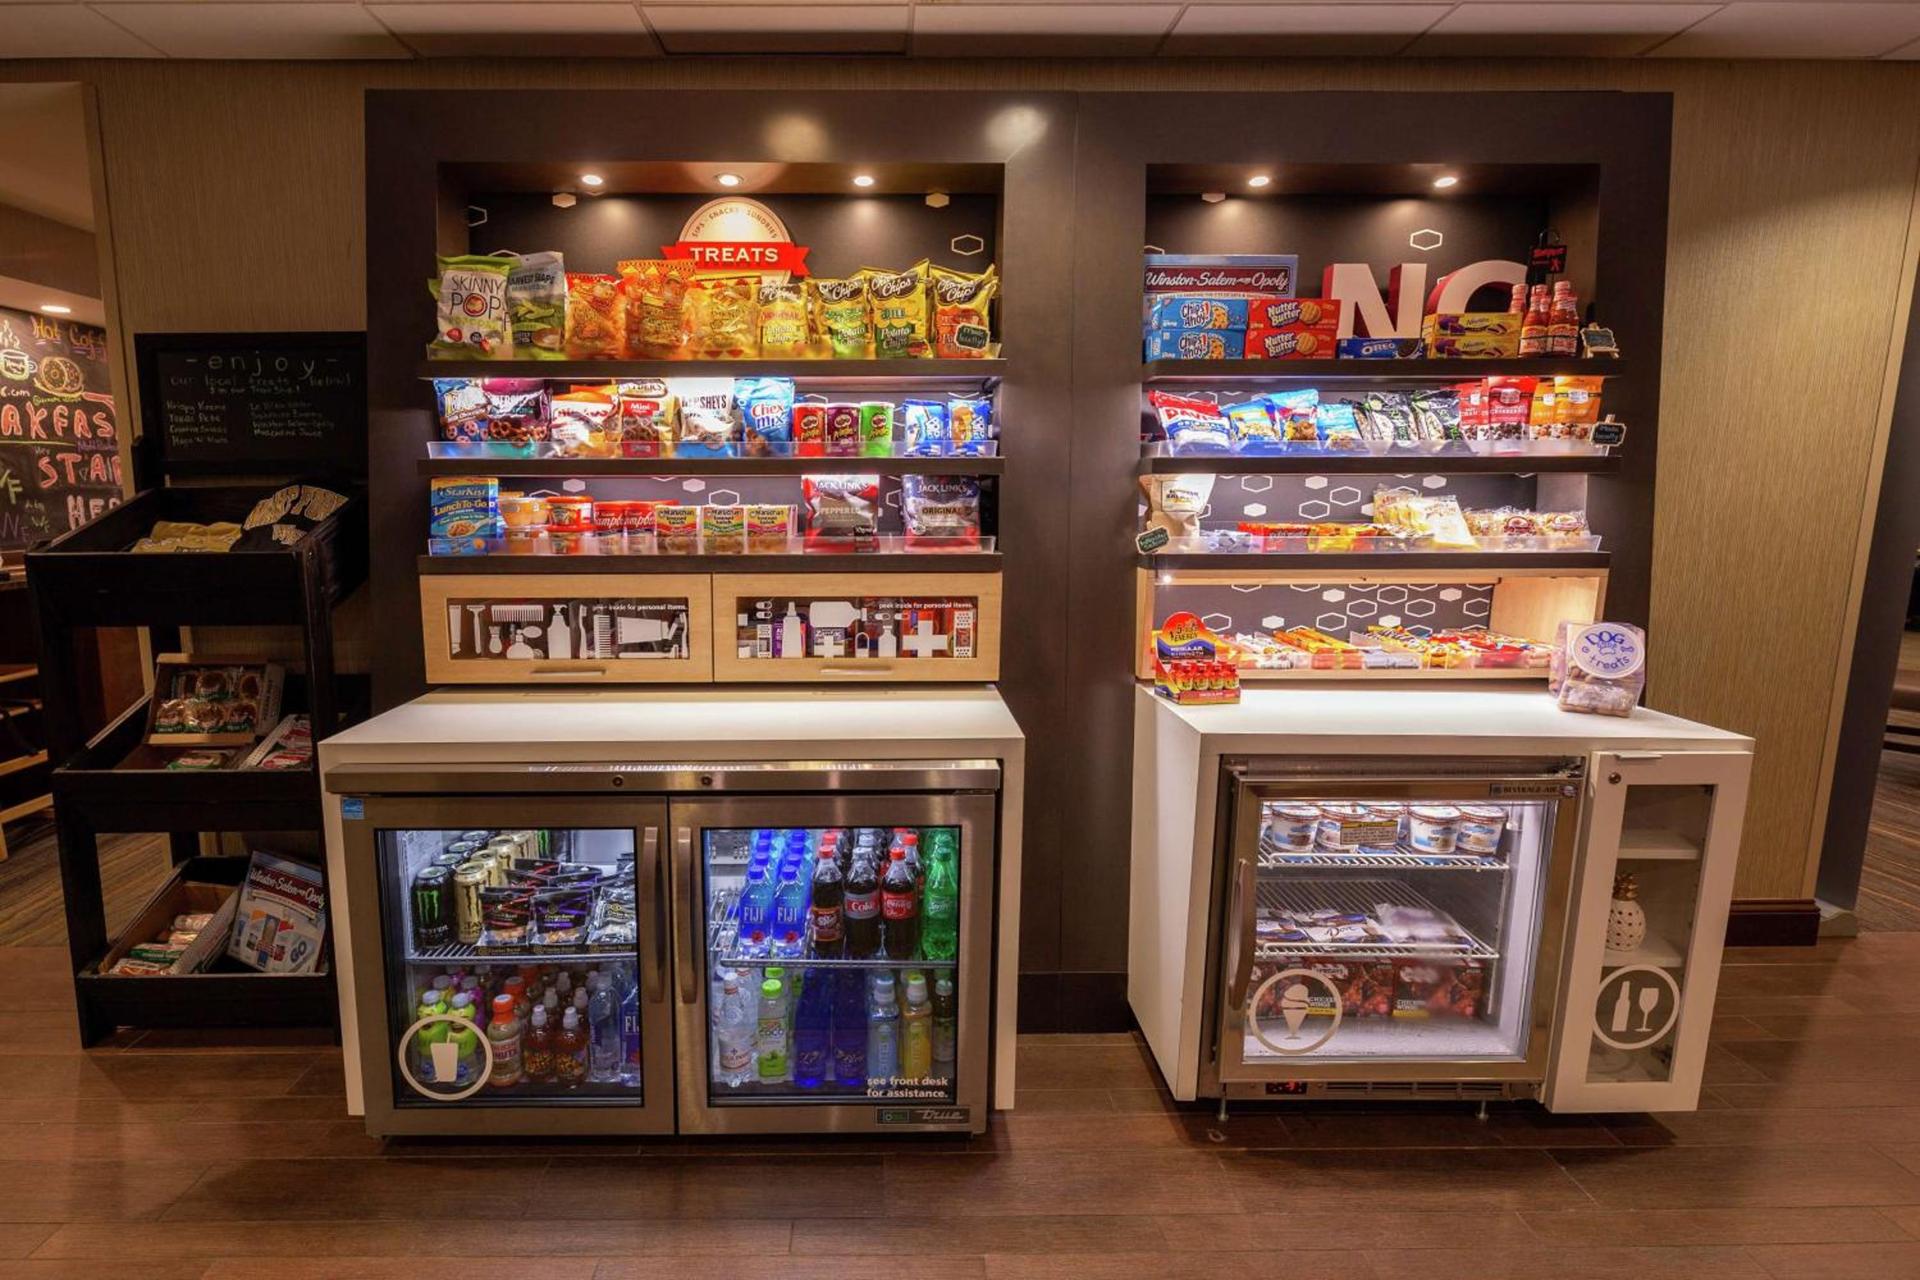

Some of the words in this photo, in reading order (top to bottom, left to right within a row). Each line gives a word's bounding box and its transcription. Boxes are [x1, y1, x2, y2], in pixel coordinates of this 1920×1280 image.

[690, 247, 778, 263] TREATS
[450, 275, 505, 295] SKINNY
[1251, 272, 1289, 291] Opoly
[449, 292, 503, 320] POP
[1268, 301, 1299, 316] Nutter
[1271, 311, 1301, 326] Butter
[1265, 331, 1295, 347] Nutter
[1269, 341, 1298, 356] Butter
[1361, 342, 1397, 355] OREO
[208, 350, 315, 380] enjoy
[751, 402, 785, 418] Chex
[755, 415, 785, 430] mix
[445, 487, 487, 498] StarKist
[434, 500, 462, 516] Lunch
[462, 499, 489, 511] To-Go
[664, 509, 695, 518] Maruchan
[627, 603, 636, 611] for
[637, 604, 666, 612] personal
[923, 602, 953, 610] personal
[1585, 629, 1625, 647] DOG
[1588, 654, 1630, 672] treats
[744, 906, 764, 923] FIJI
[777, 906, 798, 924] FIJI
[290, 940, 308, 964] GO
[624, 1015, 640, 1034] FI
[866, 1077, 887, 1087] see
[890, 1075, 919, 1086] front
[921, 1075, 949, 1087] desk
[866, 1087, 884, 1098] for
[886, 1087, 949, 1098] assistance.
